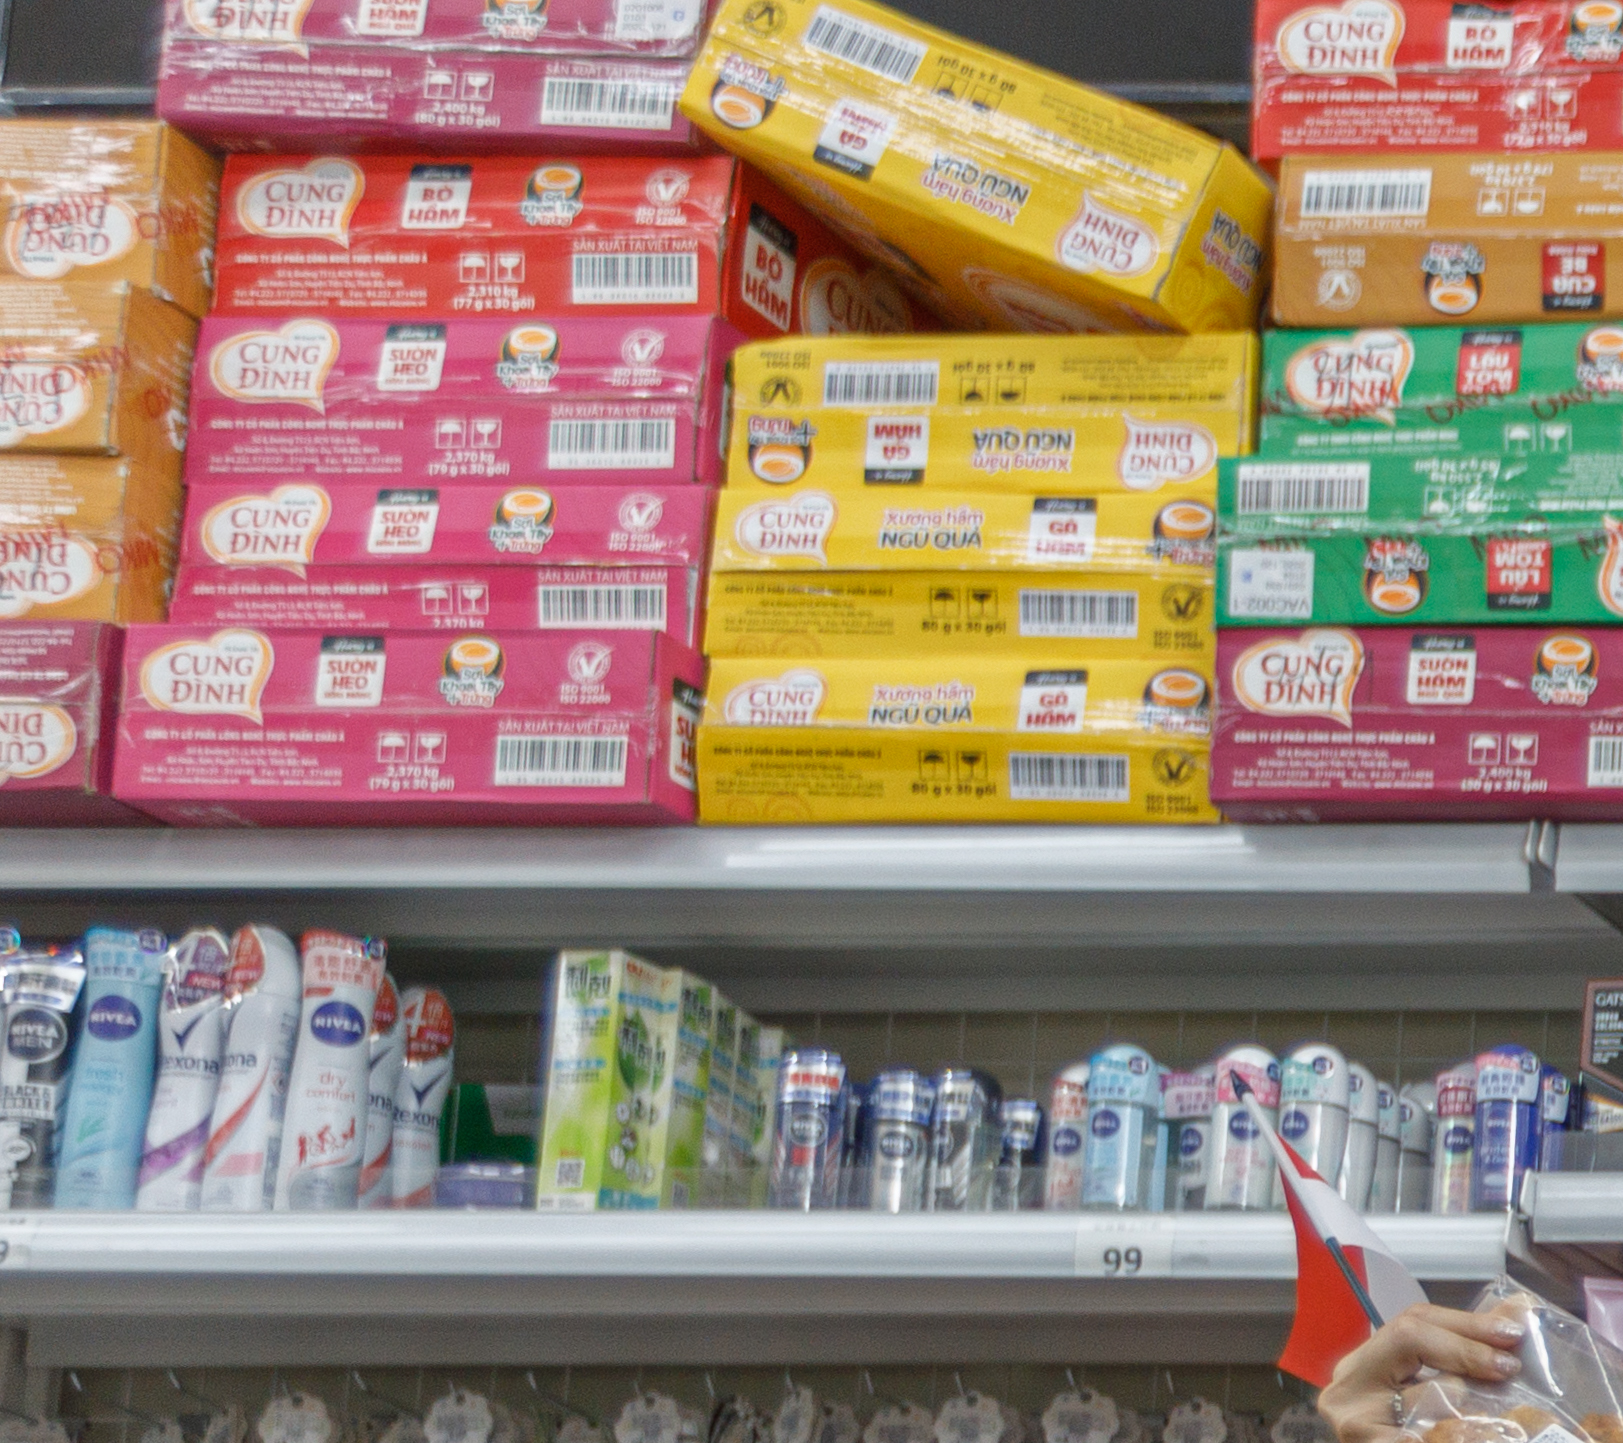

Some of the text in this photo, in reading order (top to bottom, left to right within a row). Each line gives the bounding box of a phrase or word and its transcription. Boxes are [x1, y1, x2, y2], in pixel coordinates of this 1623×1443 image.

[1304, 22, 1385, 45] CUNG
[267, 182, 346, 202] CUNG
[265, 201, 337, 228] ĐÌNH
[240, 342, 320, 364] CUNG
[240, 364, 311, 391] ĐÌNH
[231, 507, 311, 530] CUNG
[759, 512, 824, 529] CUNG
[230, 530, 302, 554] ĐÌNH
[170, 652, 254, 677] CUNG
[170, 678, 247, 705] ĐÌNH
[749, 690, 815, 707] CUNG
[89, 1011, 137, 1027] NIVEA
[313, 1014, 362, 1034] NIVEA
[1101, 1246, 1144, 1277] 99
